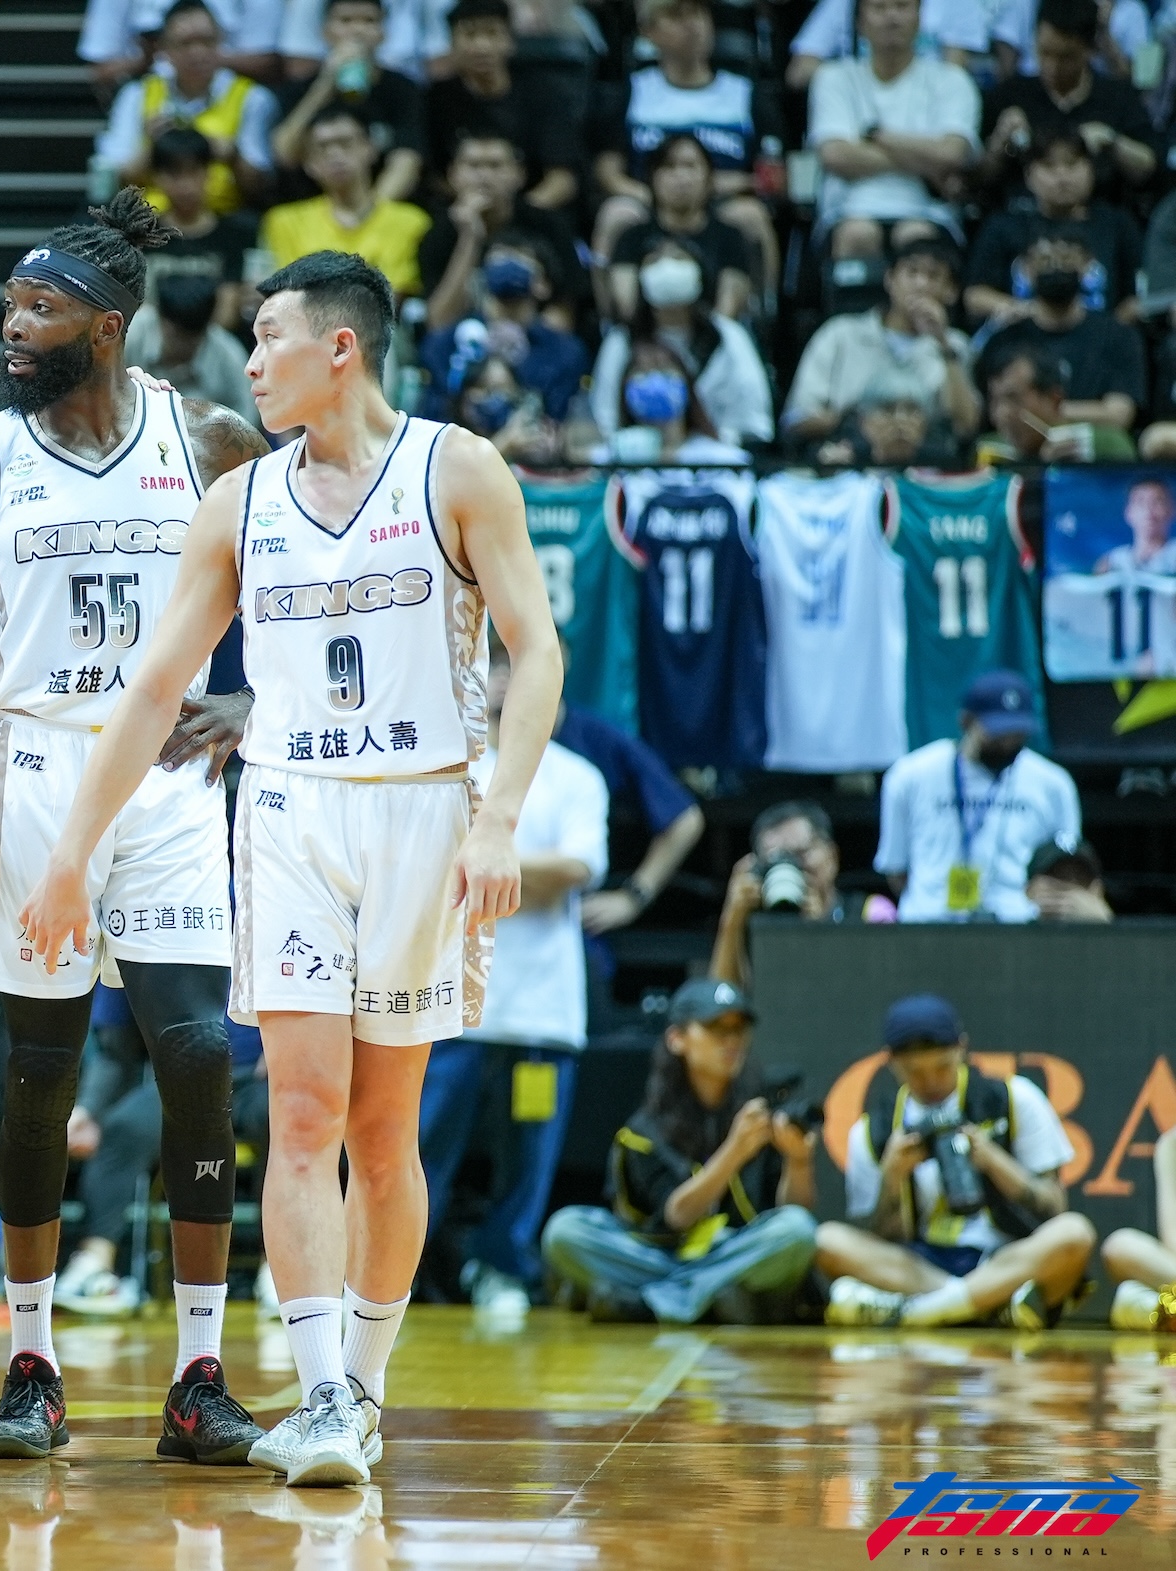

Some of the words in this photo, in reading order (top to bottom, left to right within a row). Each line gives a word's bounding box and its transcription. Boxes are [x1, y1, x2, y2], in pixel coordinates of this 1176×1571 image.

[140, 476, 185, 491] SAMPO
[15, 518, 190, 563] KINGS
[369, 520, 420, 543] SAMPO
[69, 573, 140, 650] 55
[255, 567, 433, 623] KINGS
[660, 546, 715, 634] 11
[932, 556, 989, 639] 11
[45, 665, 125, 695] 遠雄人
[325, 635, 365, 711] 9
[287, 720, 418, 761] 遠雄人壽
[132, 906, 225, 933] 王道銀行
[357, 980, 455, 1015] 王道銀行
